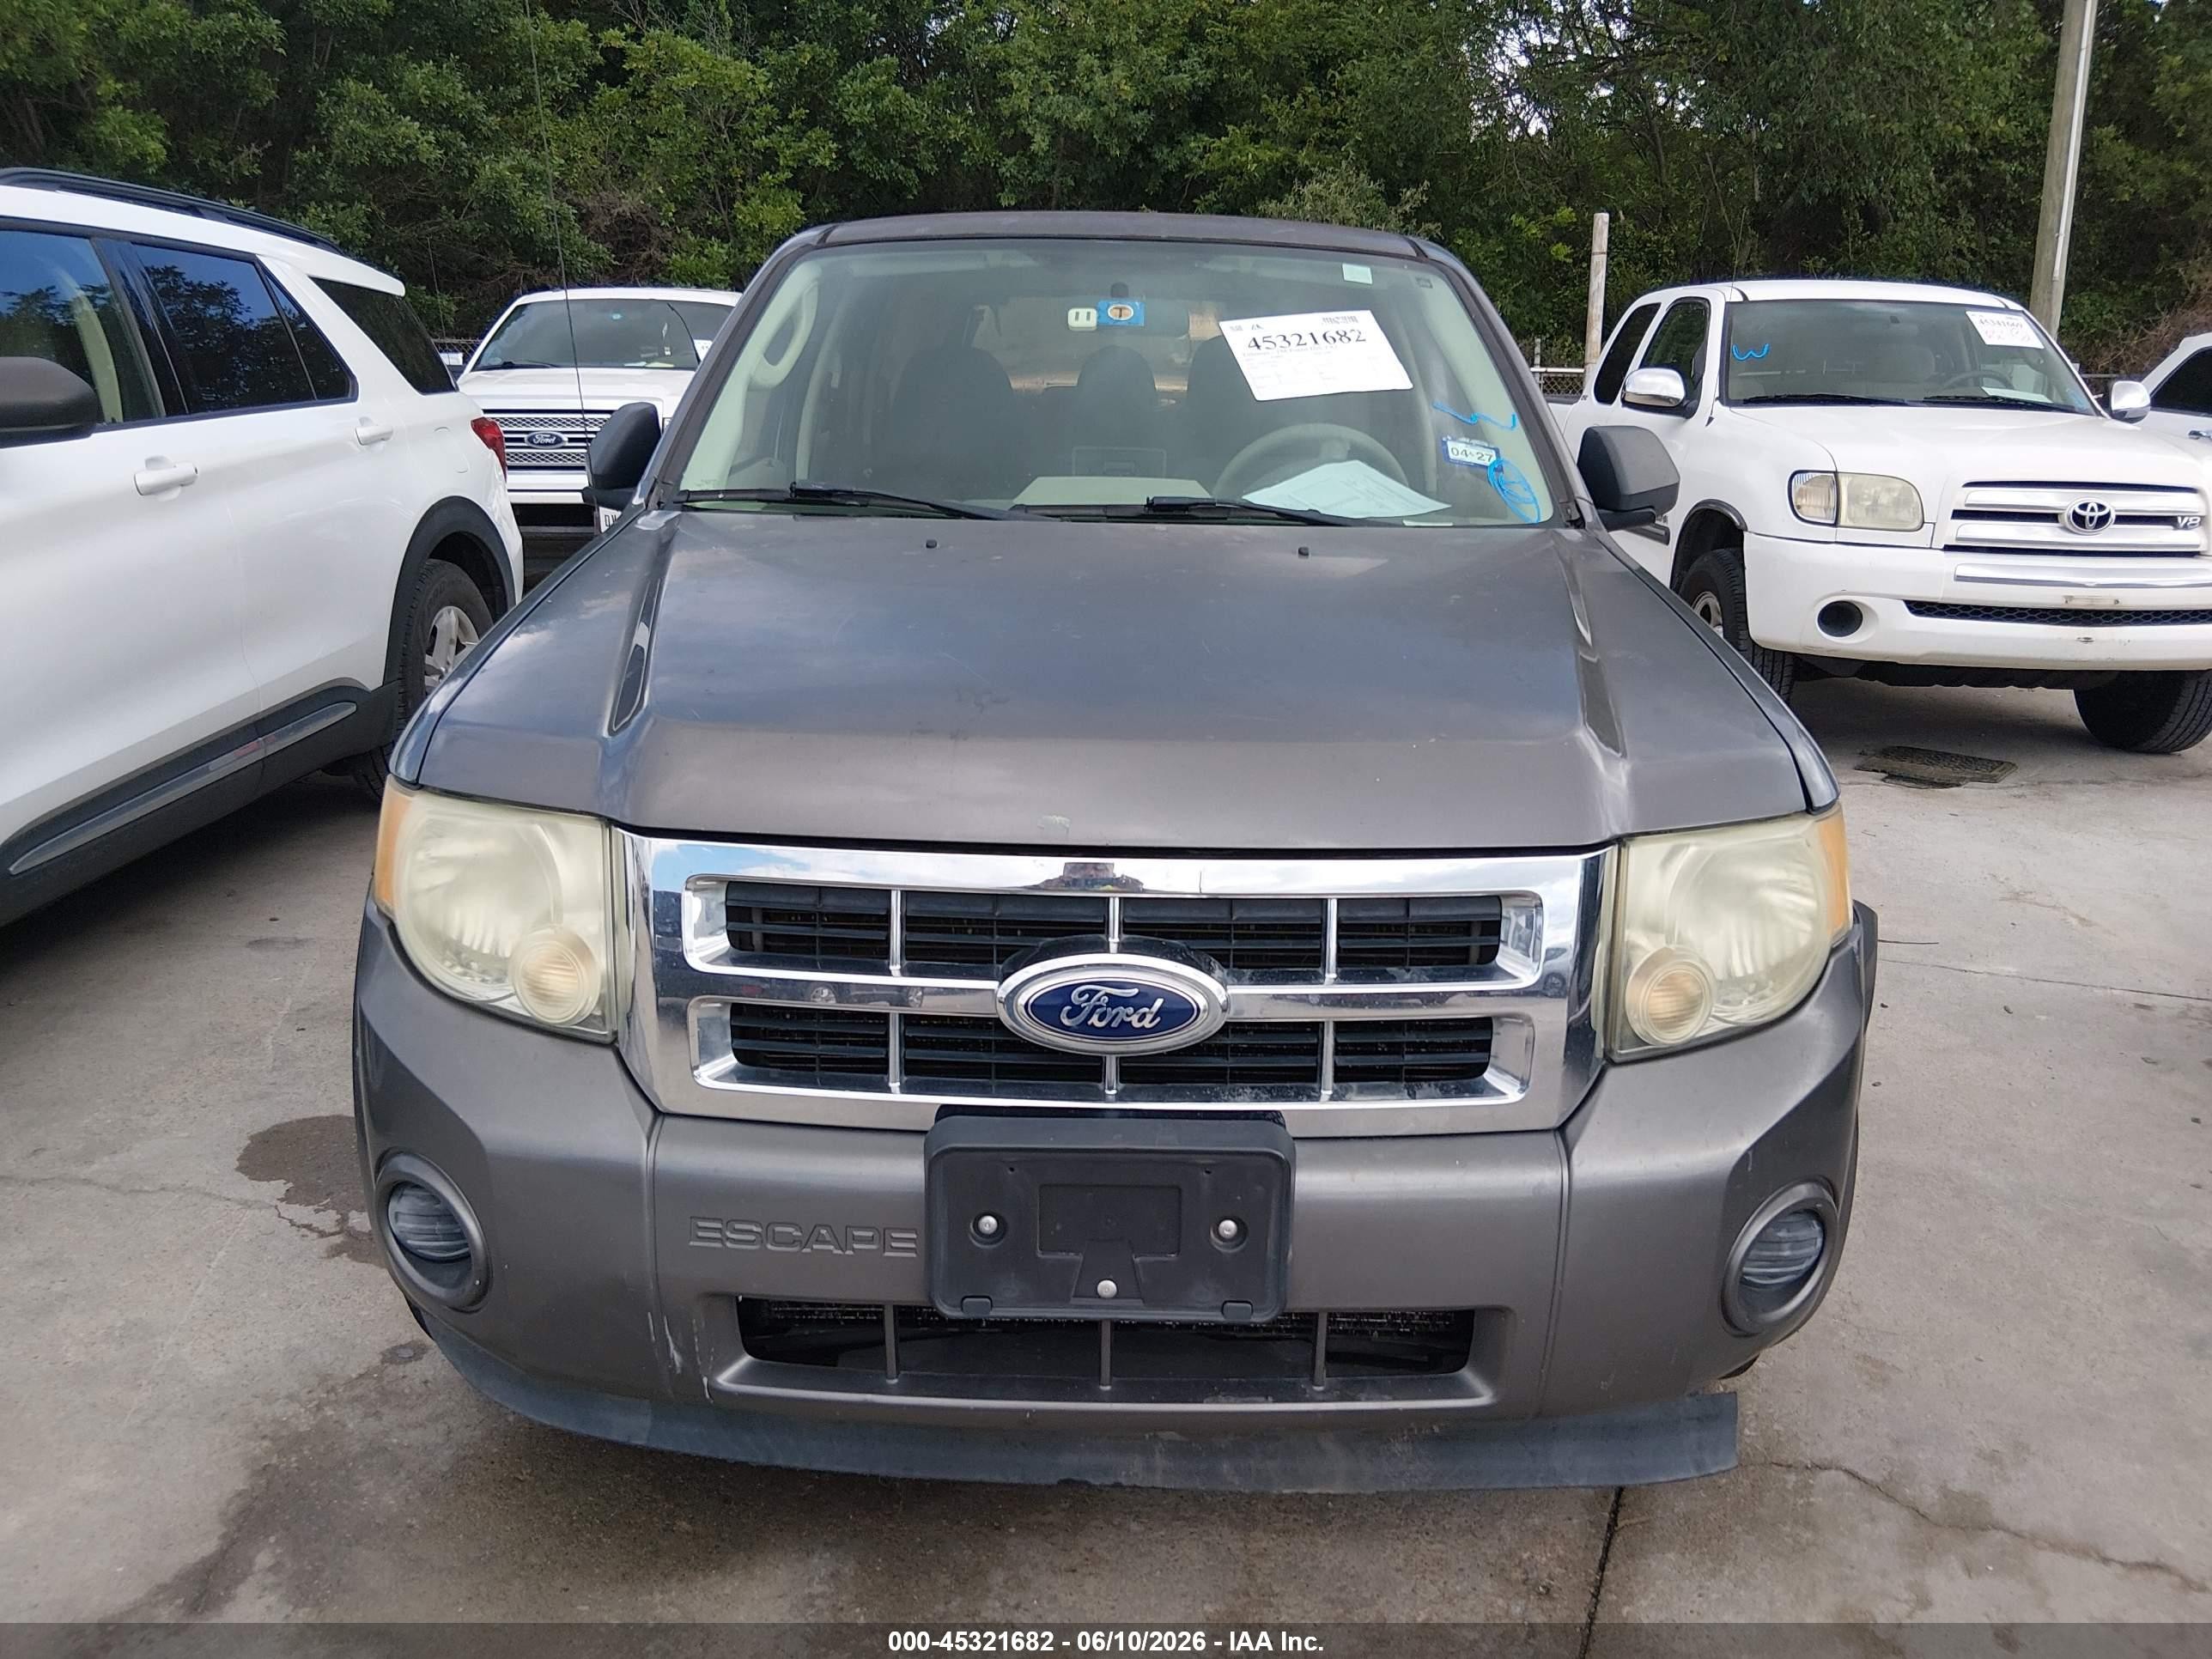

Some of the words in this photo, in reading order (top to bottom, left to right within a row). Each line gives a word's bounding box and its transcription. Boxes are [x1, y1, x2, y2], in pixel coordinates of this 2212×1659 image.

[1248, 328, 1367, 350] 45321682
[532, 434, 556, 444] Ford
[1450, 447, 1494, 462] 04-27
[2177, 516, 2202, 528] V8
[1060, 984, 1164, 1029] Ford
[689, 1216, 918, 1257] ESCAPE
